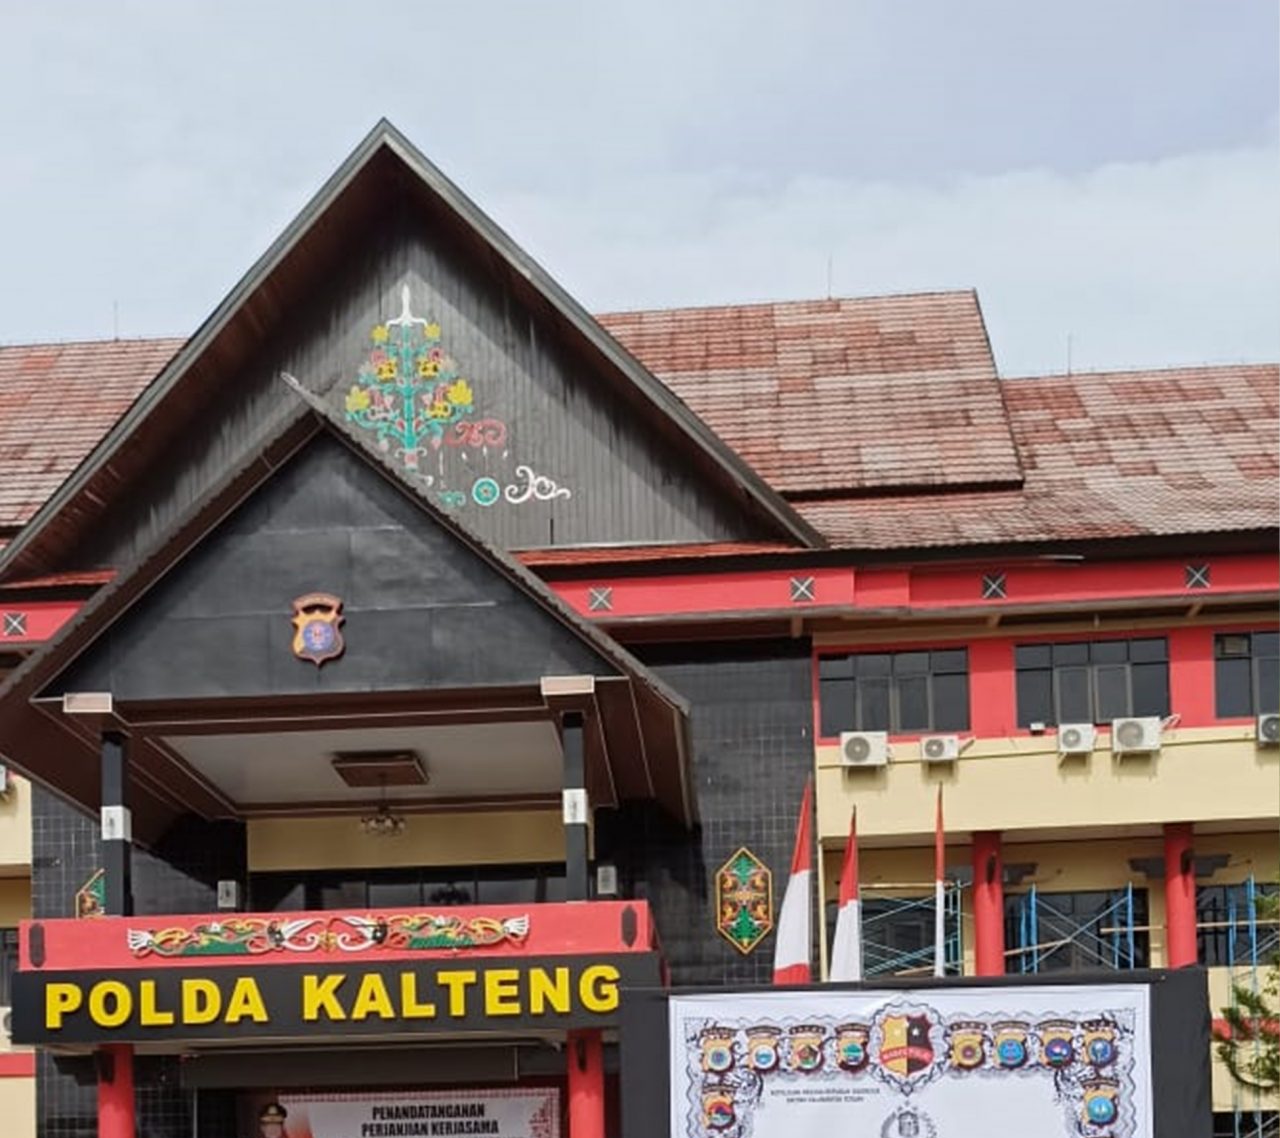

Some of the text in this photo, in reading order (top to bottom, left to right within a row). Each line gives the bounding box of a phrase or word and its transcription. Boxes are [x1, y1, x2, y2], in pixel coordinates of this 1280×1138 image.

[45, 964, 621, 1029] POLDA KALTENG
[361, 1119, 499, 1138] PERJANJIAN KERJASAMA
